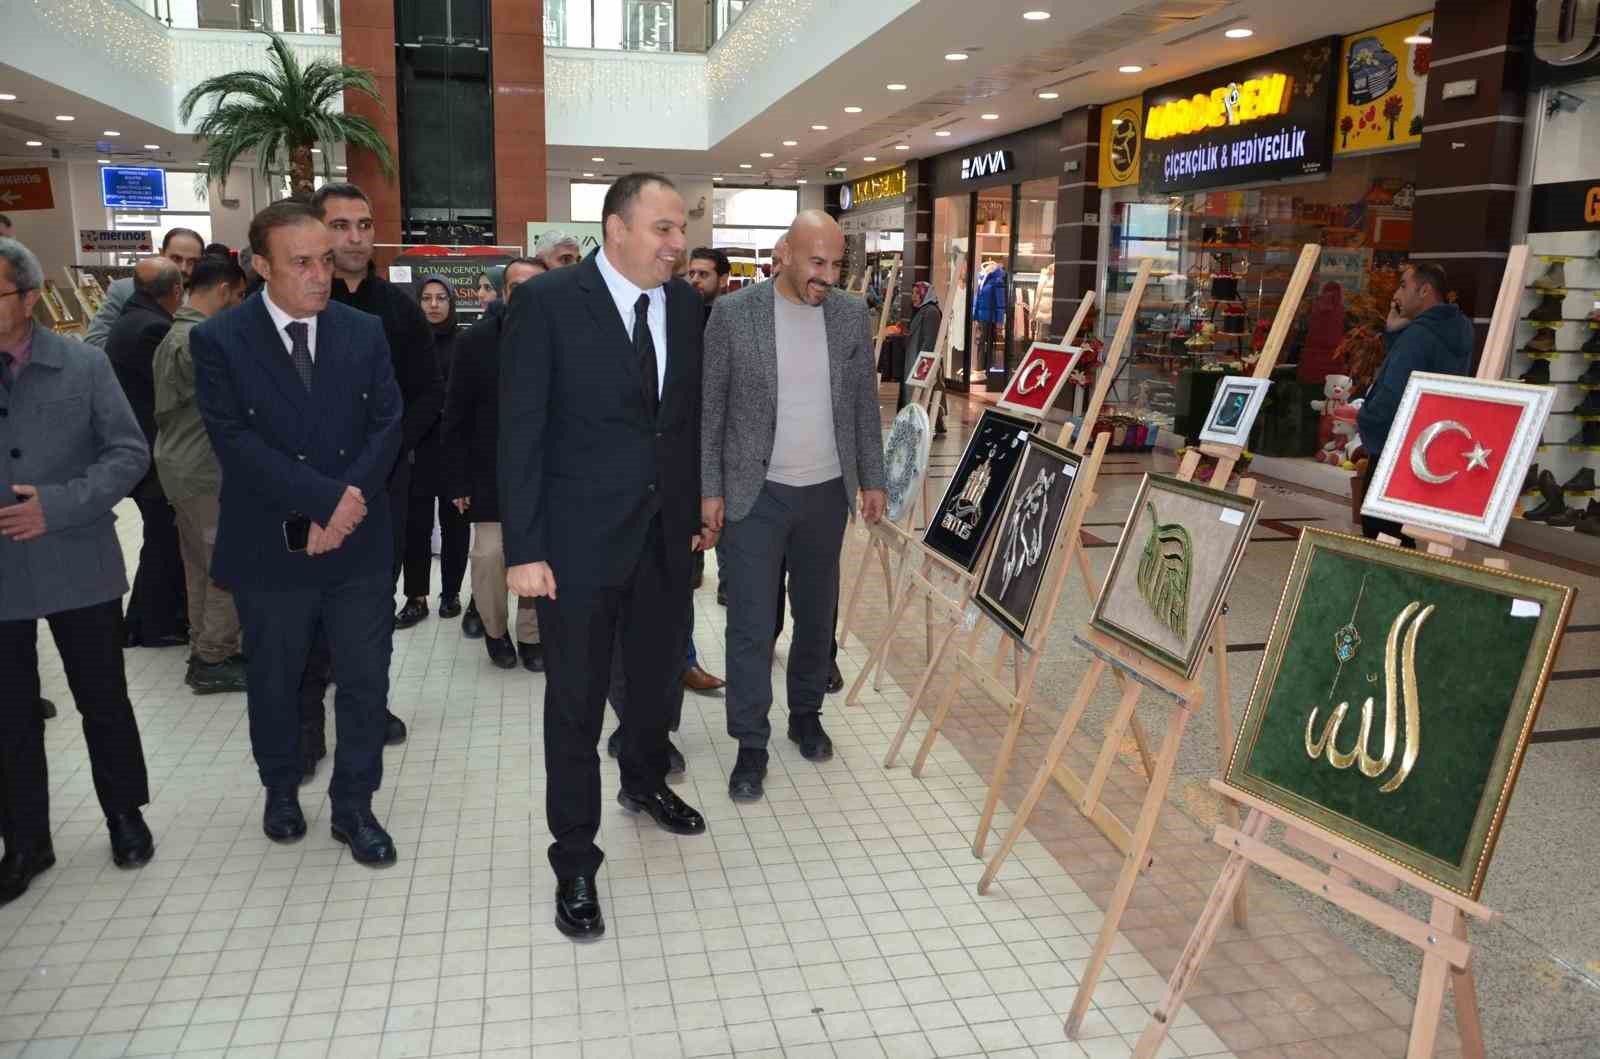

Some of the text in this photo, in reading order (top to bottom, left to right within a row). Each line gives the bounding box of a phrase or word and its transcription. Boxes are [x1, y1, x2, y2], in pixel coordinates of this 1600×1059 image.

[971, 150, 1006, 177] AVVA
[1164, 126, 1306, 182] ÇİÇEKÇİLİK & HEDİYECİLİK
[100, 229, 146, 241] merinos
[418, 265, 450, 275] TATVAN
